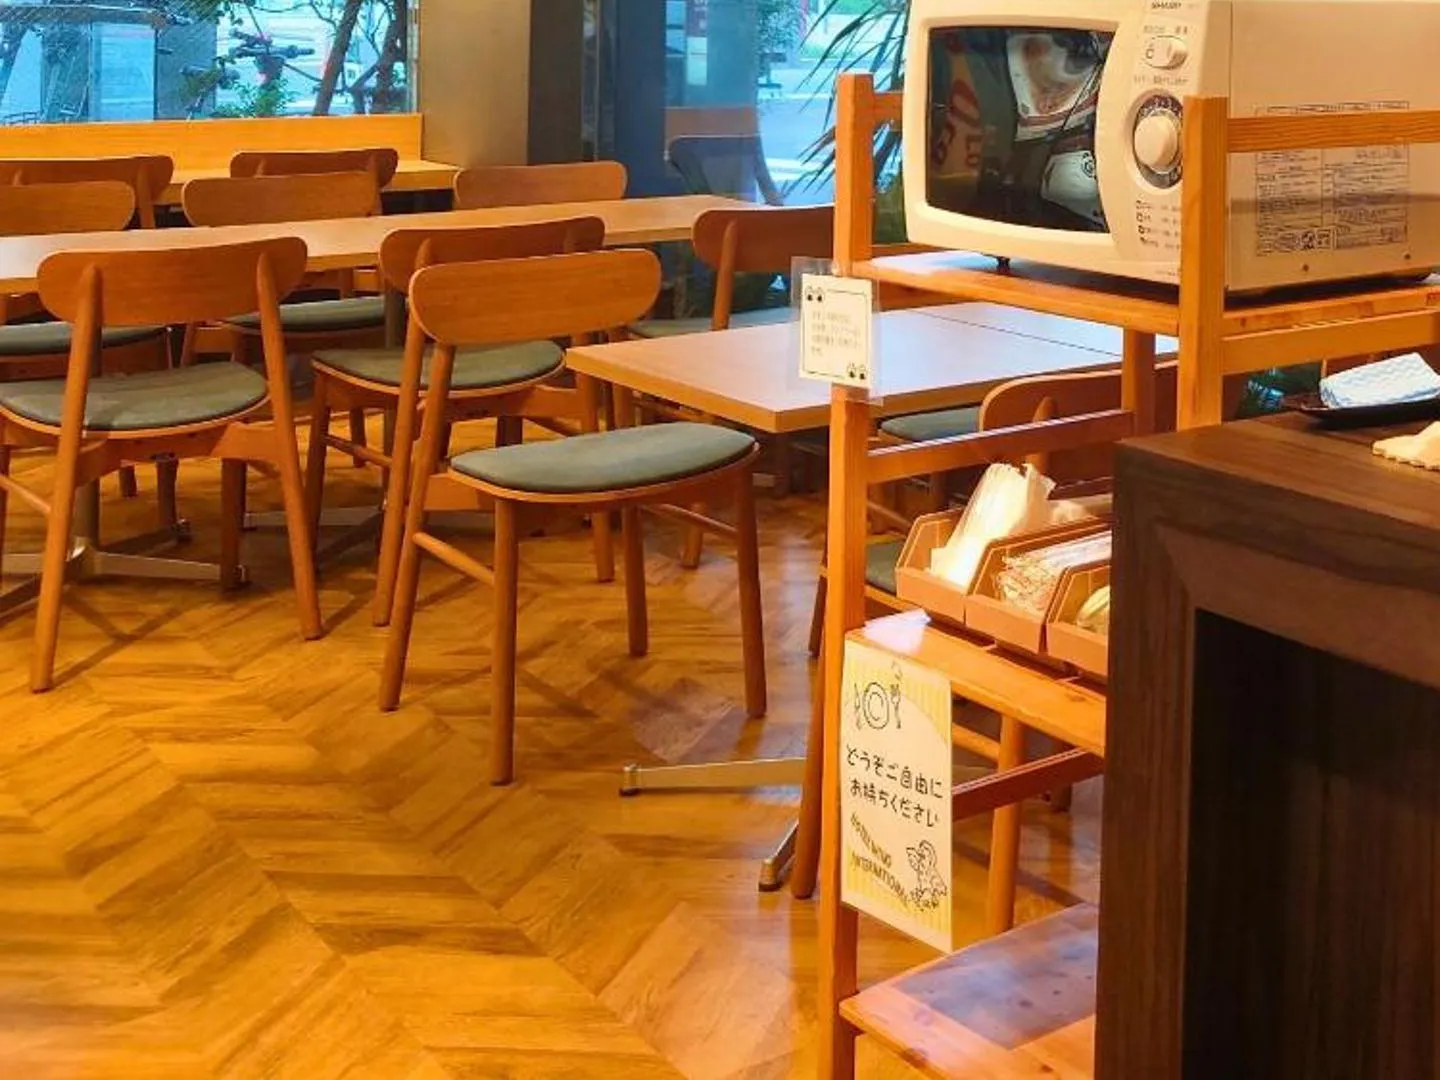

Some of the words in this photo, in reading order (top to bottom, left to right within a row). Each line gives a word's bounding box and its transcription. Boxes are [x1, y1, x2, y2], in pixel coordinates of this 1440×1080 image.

[846, 743, 943, 799] どうぞご自由に
[850, 777, 938, 828] お持ちください
